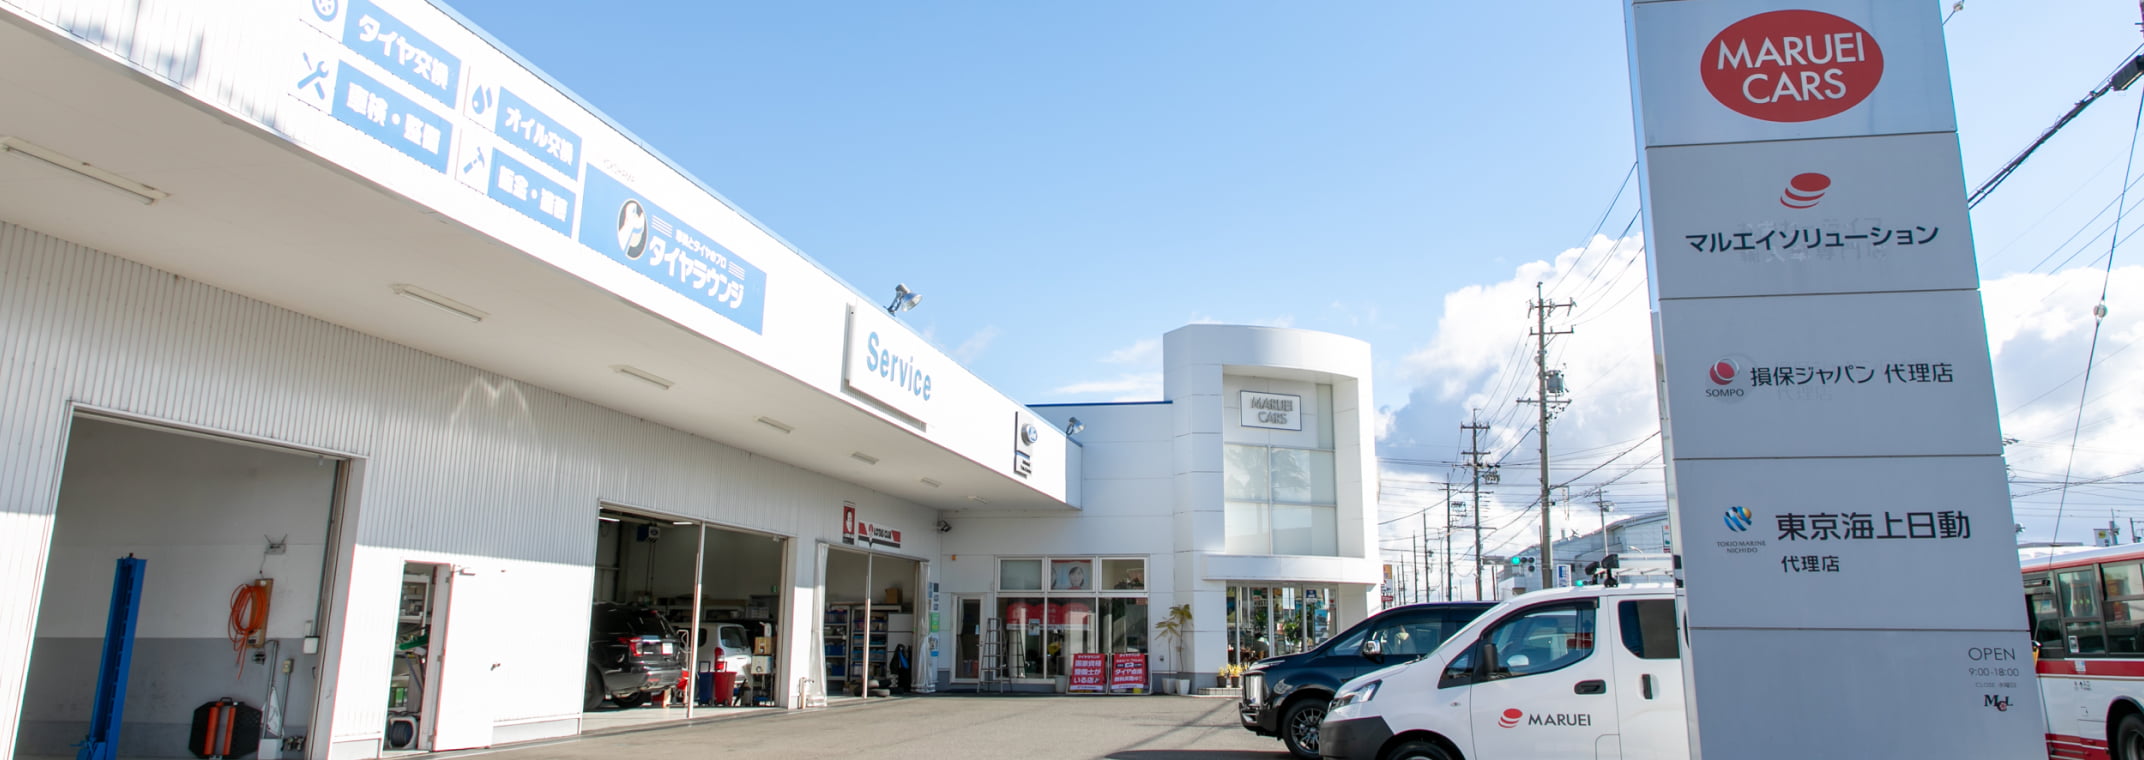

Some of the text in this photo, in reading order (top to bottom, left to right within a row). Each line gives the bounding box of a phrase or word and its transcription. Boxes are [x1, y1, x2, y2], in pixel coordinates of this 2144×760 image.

[1717, 31, 1865, 70] MARUEI
[1742, 67, 1847, 104] CARS
[1685, 226, 1939, 253] マルエイソリューション
[649, 236, 744, 309] タイヤラウンジ
[866, 331, 932, 401] Service
[1750, 362, 1954, 388] 損保ジャパン 代理店
[1250, 396, 1293, 412] MARUEI
[1705, 388, 1744, 398] SOMPO
[1257, 410, 1288, 425] CARS
[1775, 510, 1971, 541] 東京海上日動
[1781, 555, 1840, 573] 代理店
[1968, 647, 2016, 661] OPEN
[1528, 713, 1592, 727] MARUEI
